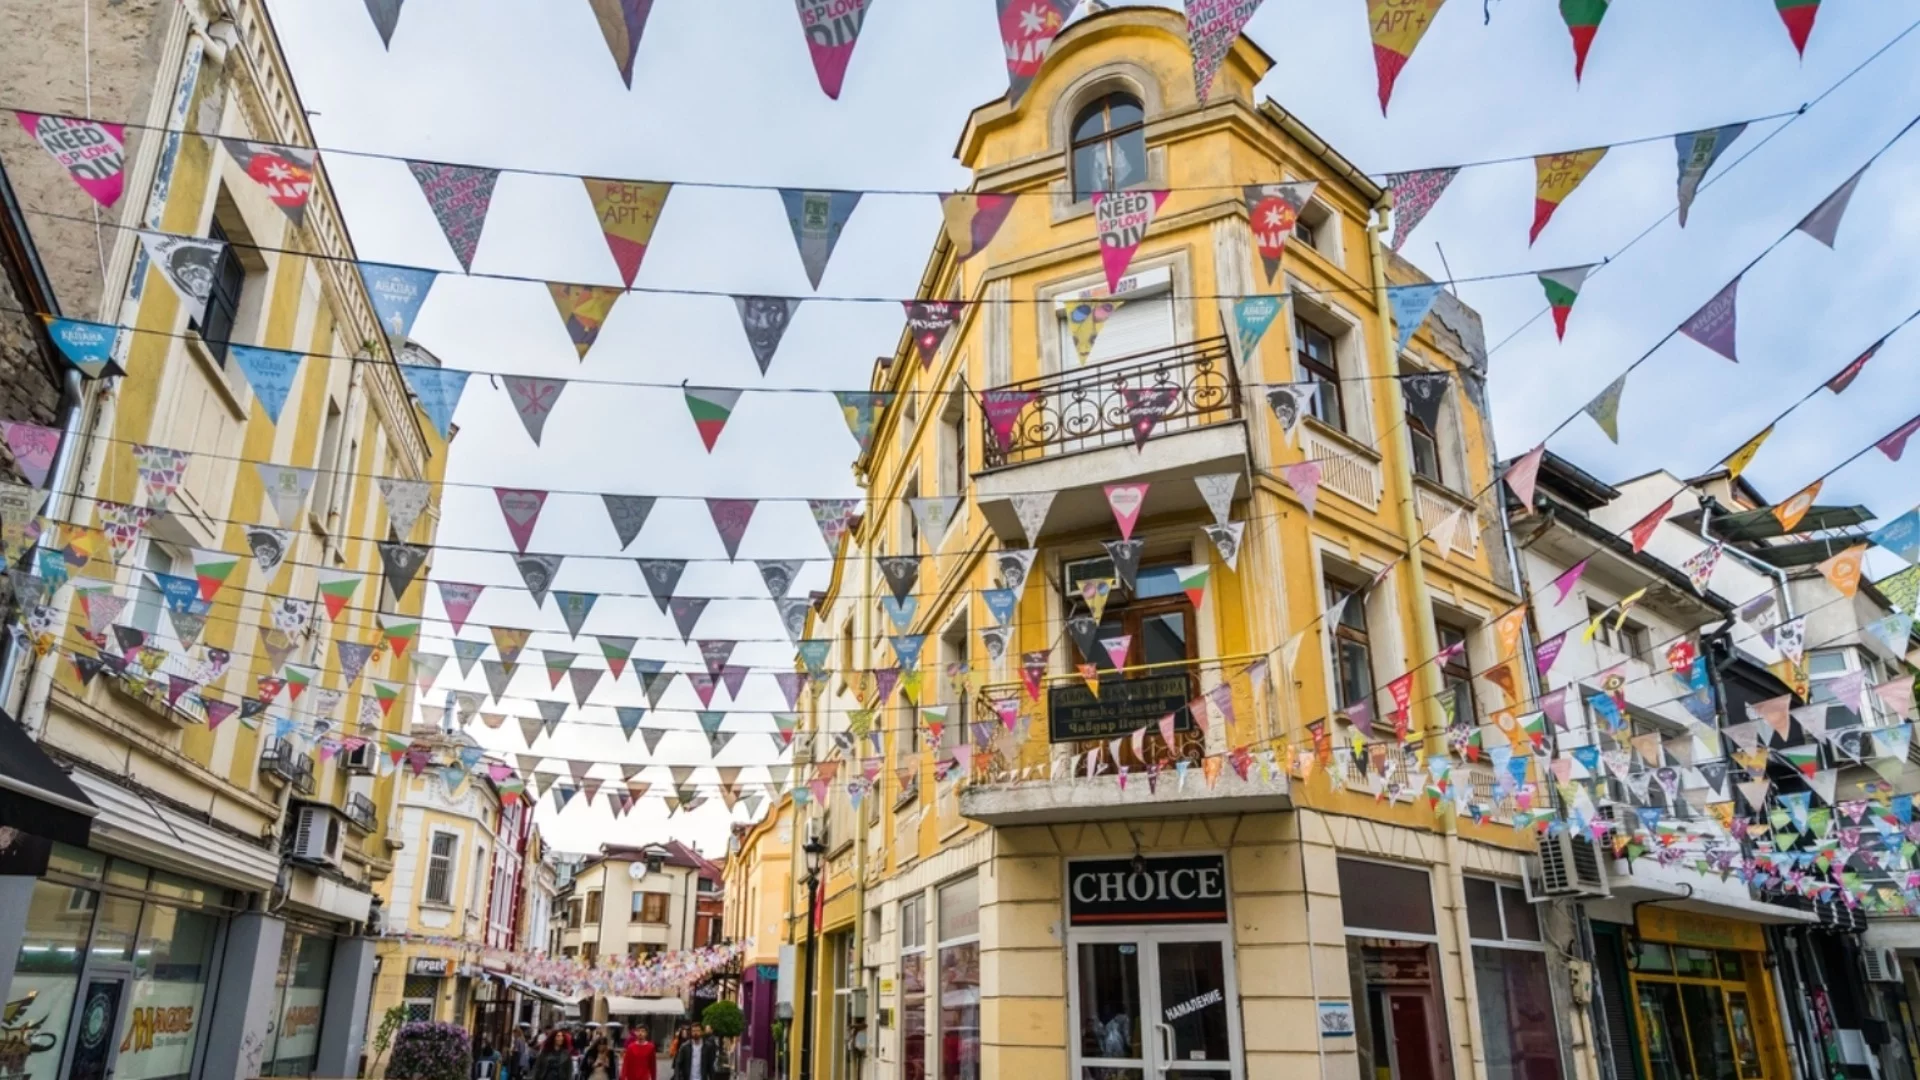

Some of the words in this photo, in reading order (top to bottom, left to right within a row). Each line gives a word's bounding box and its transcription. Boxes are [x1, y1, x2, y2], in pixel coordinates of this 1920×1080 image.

[43, 127, 104, 154] NEED
[1099, 196, 1148, 221] NEED
[1073, 868, 1223, 903] CHOICE
